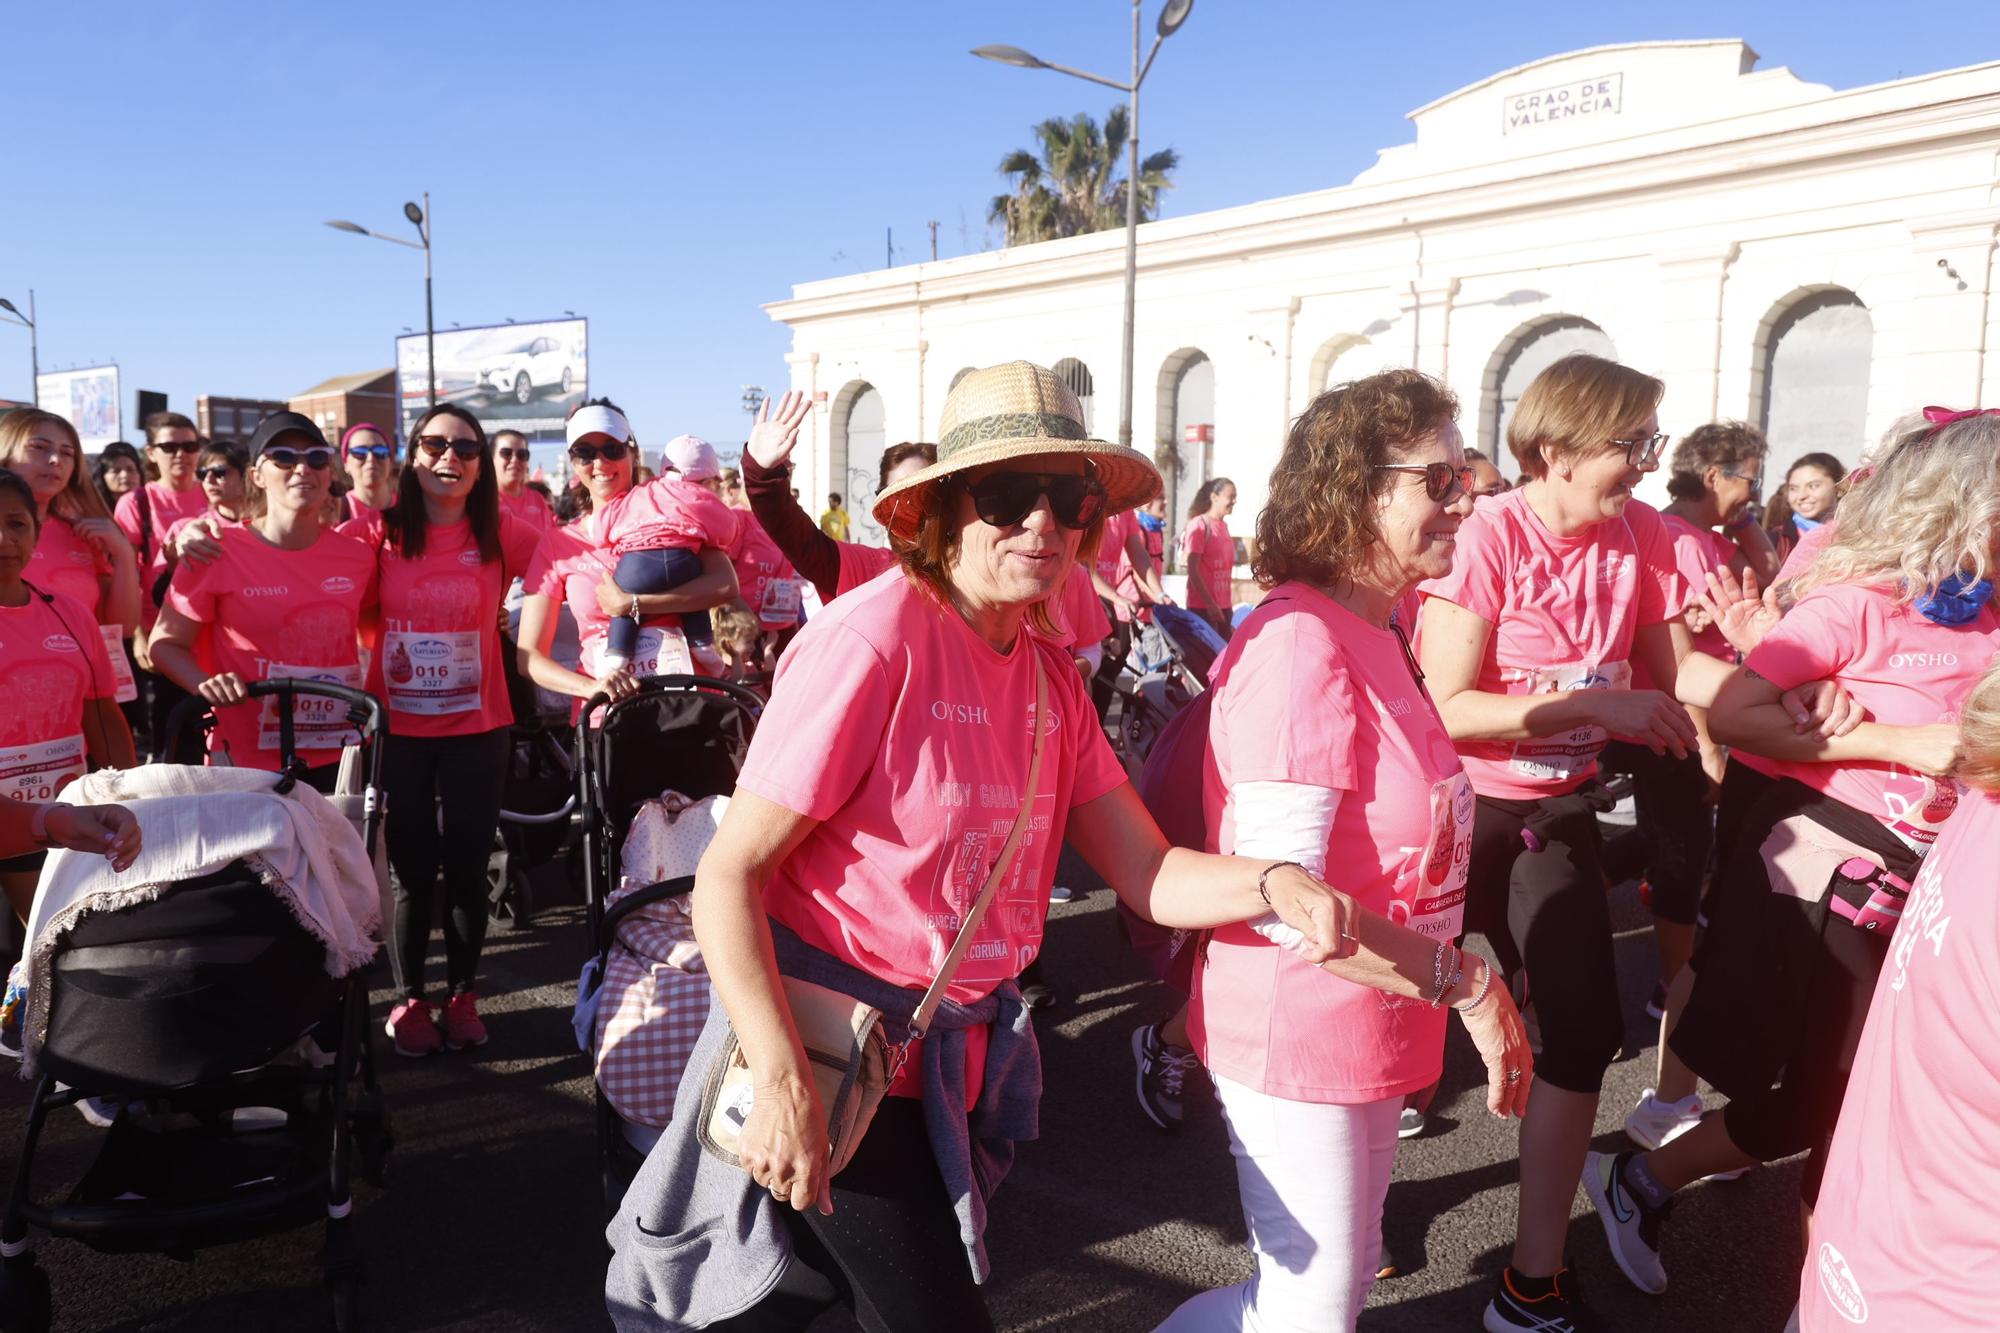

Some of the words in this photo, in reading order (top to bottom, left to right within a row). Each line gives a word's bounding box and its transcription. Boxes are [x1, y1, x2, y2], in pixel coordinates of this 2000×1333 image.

[1515, 90, 1569, 111] GRAO
[1582, 80, 1610, 97] DE
[1510, 97, 1612, 127] VALENCIA
[243, 586, 288, 597] OYSHO
[1888, 652, 1958, 668] OYSHO
[415, 665, 448, 677] 016
[422, 680, 442, 688] 3327
[301, 700, 334, 712] 016
[1569, 729, 1591, 742] 4136
[938, 782, 970, 807] HOY
[1425, 896, 1452, 911] CARRERA
[1416, 918, 1451, 935] OYSHO
[969, 940, 1008, 960] CORUÑA
